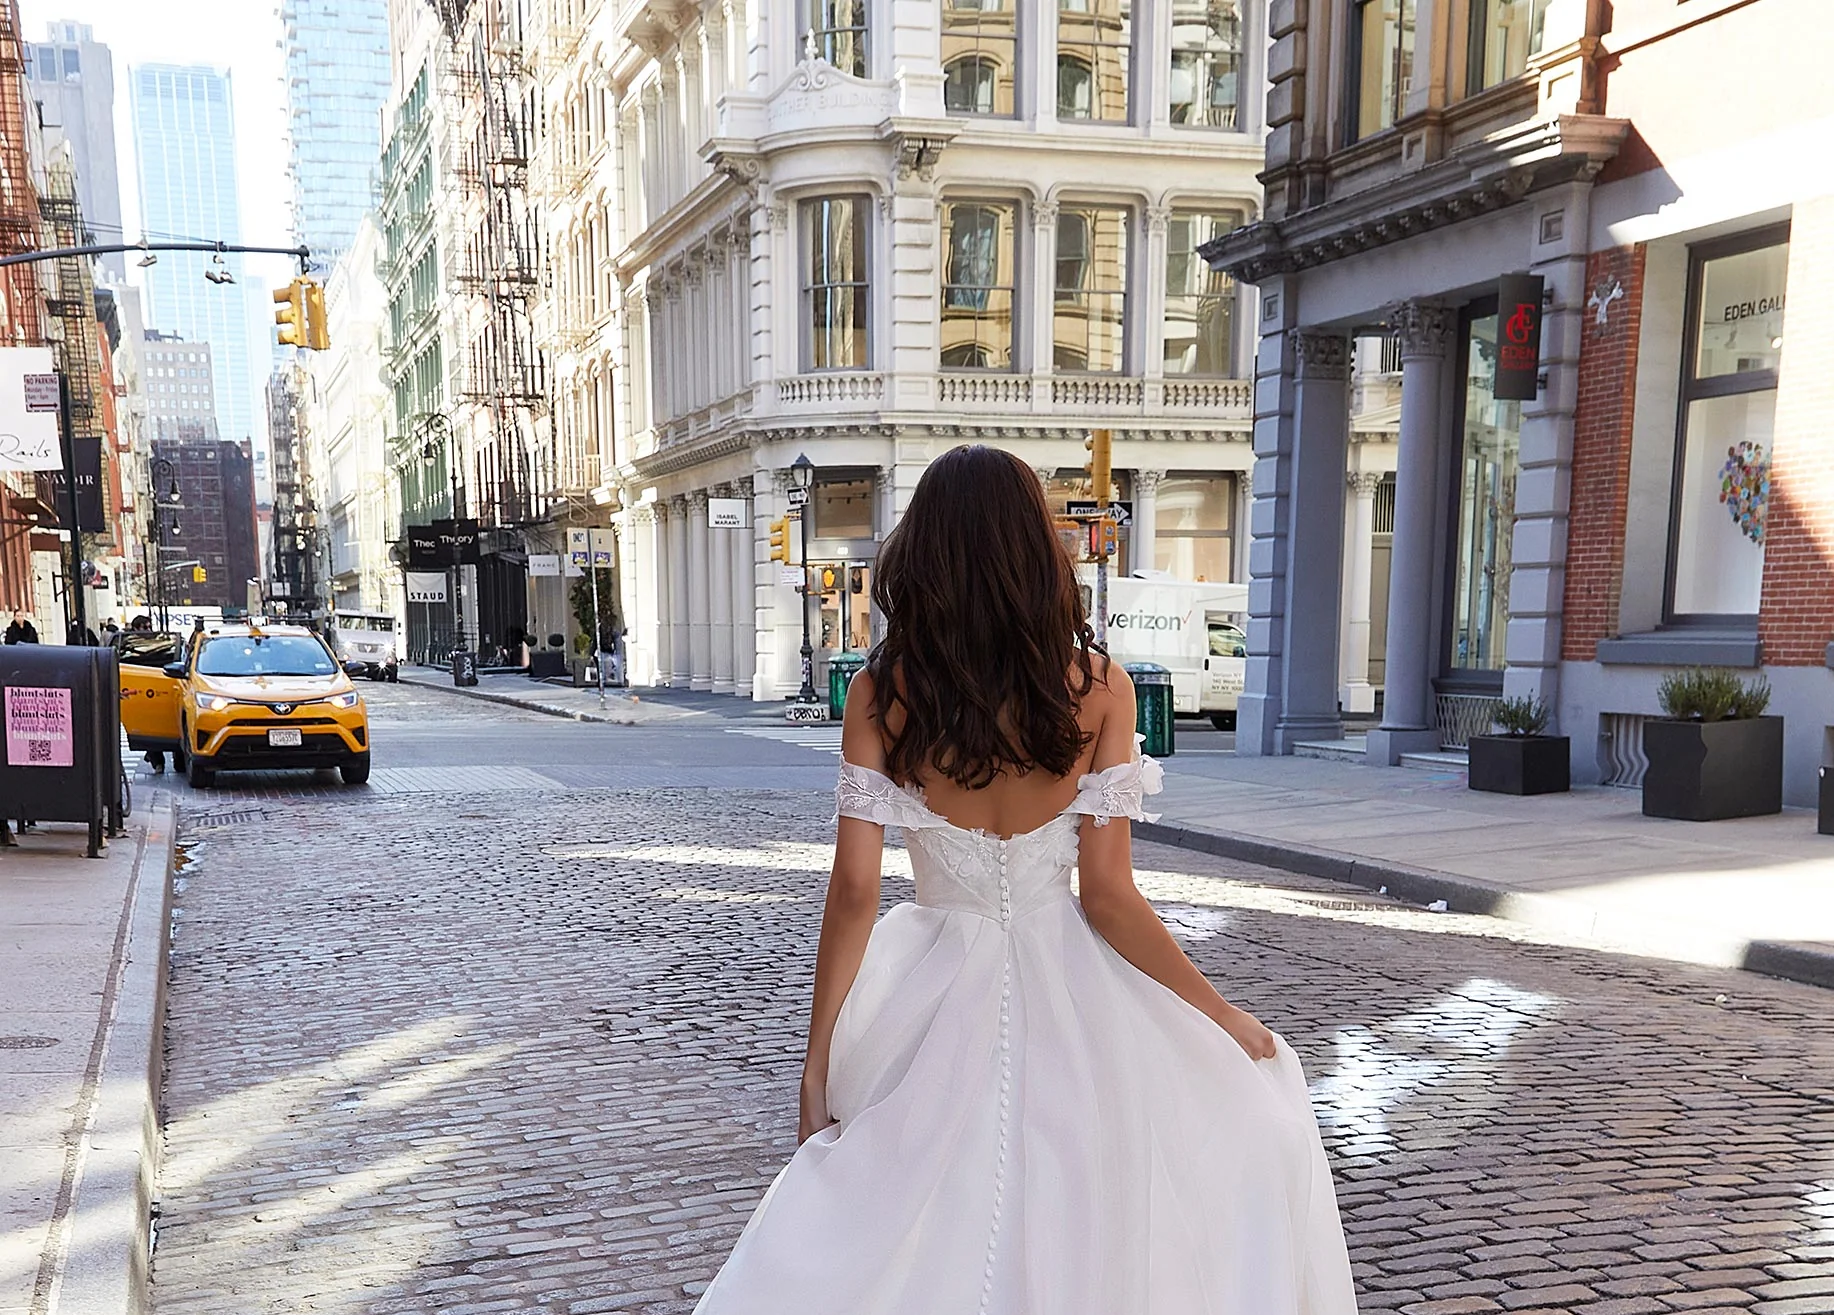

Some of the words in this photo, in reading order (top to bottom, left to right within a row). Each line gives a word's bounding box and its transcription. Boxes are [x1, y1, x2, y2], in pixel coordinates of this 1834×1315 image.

[1723, 300, 1756, 322] EDEN
[1502, 346, 1535, 359] EDEN
[26, 377, 34, 385] NO
[35, 377, 58, 385] PARKING
[0, 434, 52, 463] Rails
[440, 535, 474, 545] Thory
[410, 592, 444, 600] STAUD
[1107, 609, 1182, 631] verizon
